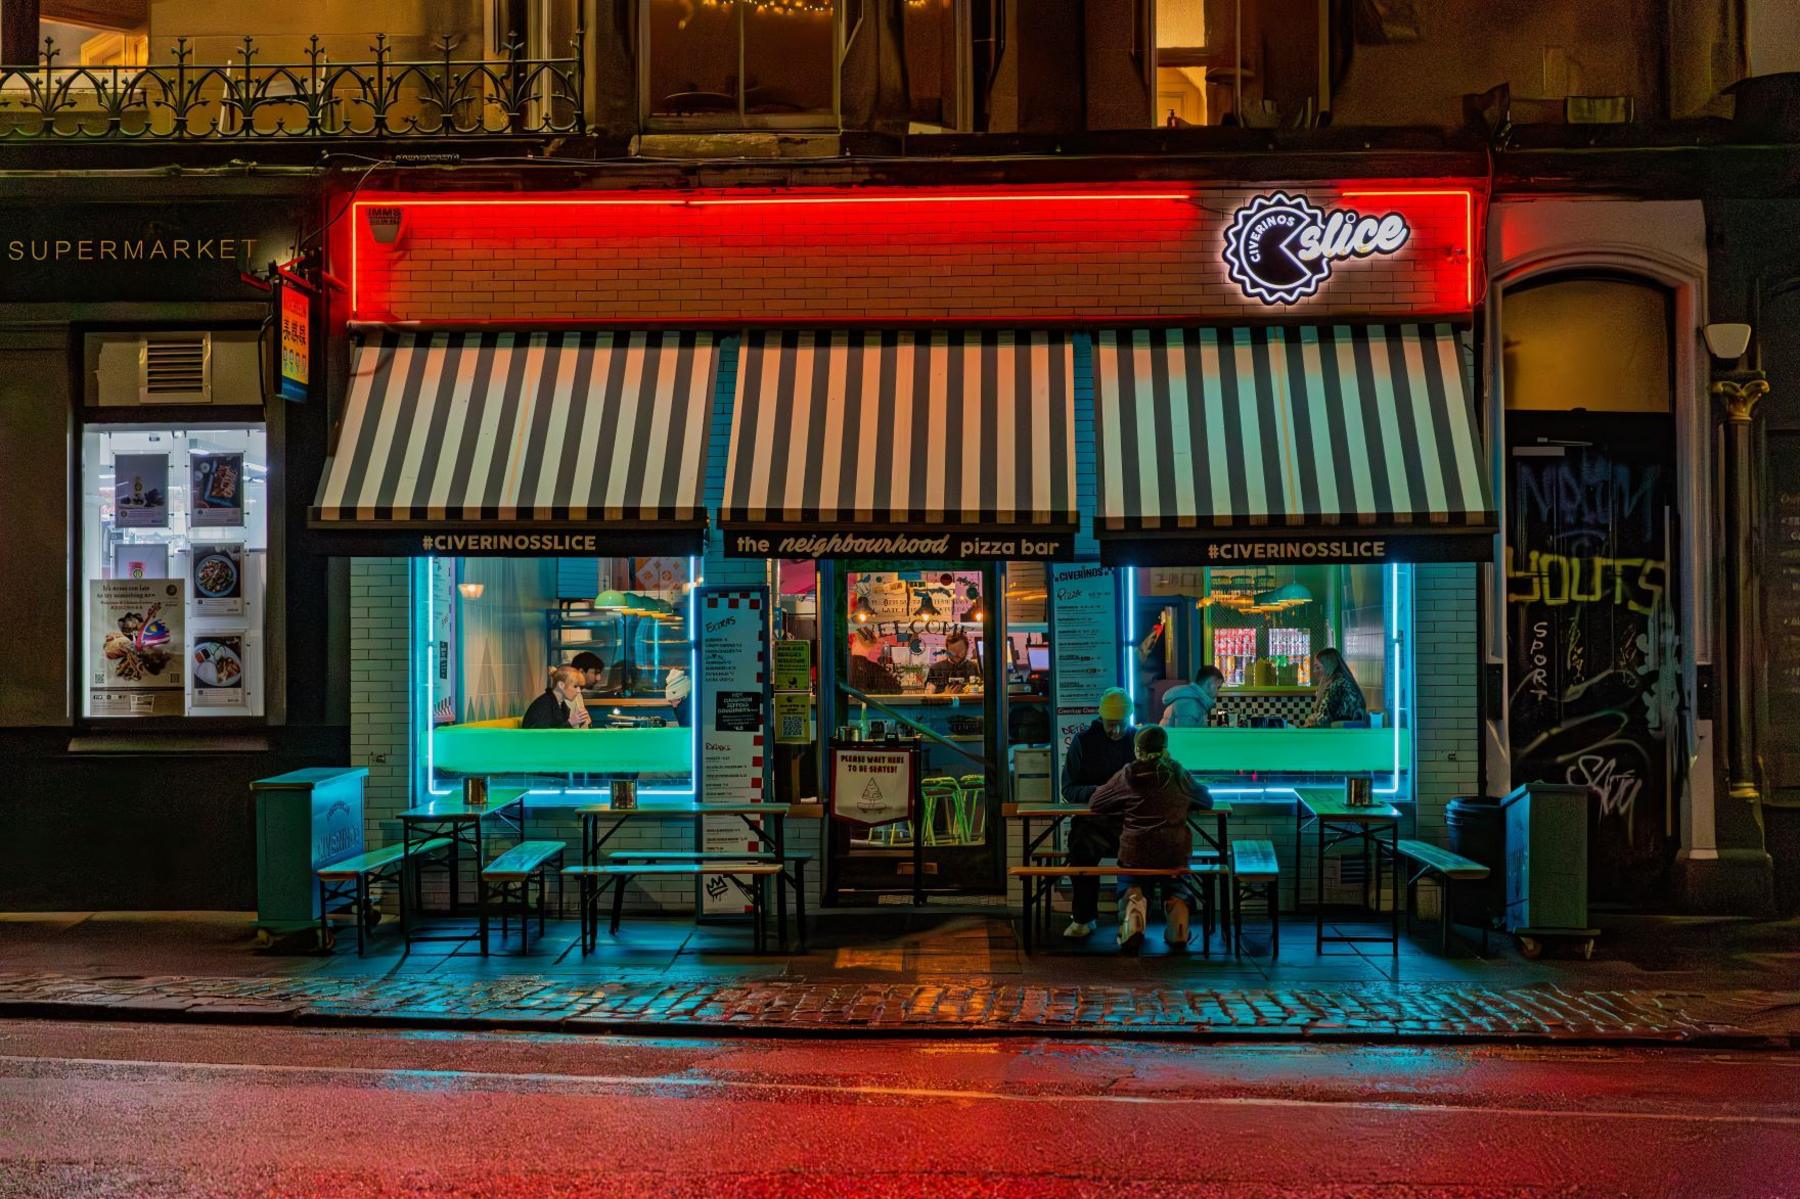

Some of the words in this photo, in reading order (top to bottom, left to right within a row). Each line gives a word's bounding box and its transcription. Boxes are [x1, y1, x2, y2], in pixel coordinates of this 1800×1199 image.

[1248, 214, 1295, 263] CIVERINOS
[1298, 211, 1408, 261] slice
[8, 239, 258, 261] SUPERMARKET
[422, 534, 597, 551] #CIVERINOSSLICE
[737, 536, 770, 552] the
[778, 533, 950, 558] neighbourhood
[960, 537, 1015, 558] pizza
[1021, 538, 1059, 555] bar
[1208, 541, 1385, 559] #CIVERINOSSLICE
[1059, 567, 1103, 581] CIVERINOS
[1529, 621, 1548, 702] SPORT
[840, 754, 865, 764] PLEASE
[866, 755, 886, 764] WAIT
[887, 755, 905, 764] HERE
[848, 765, 858, 773] TO
[859, 765, 868, 773] BE
